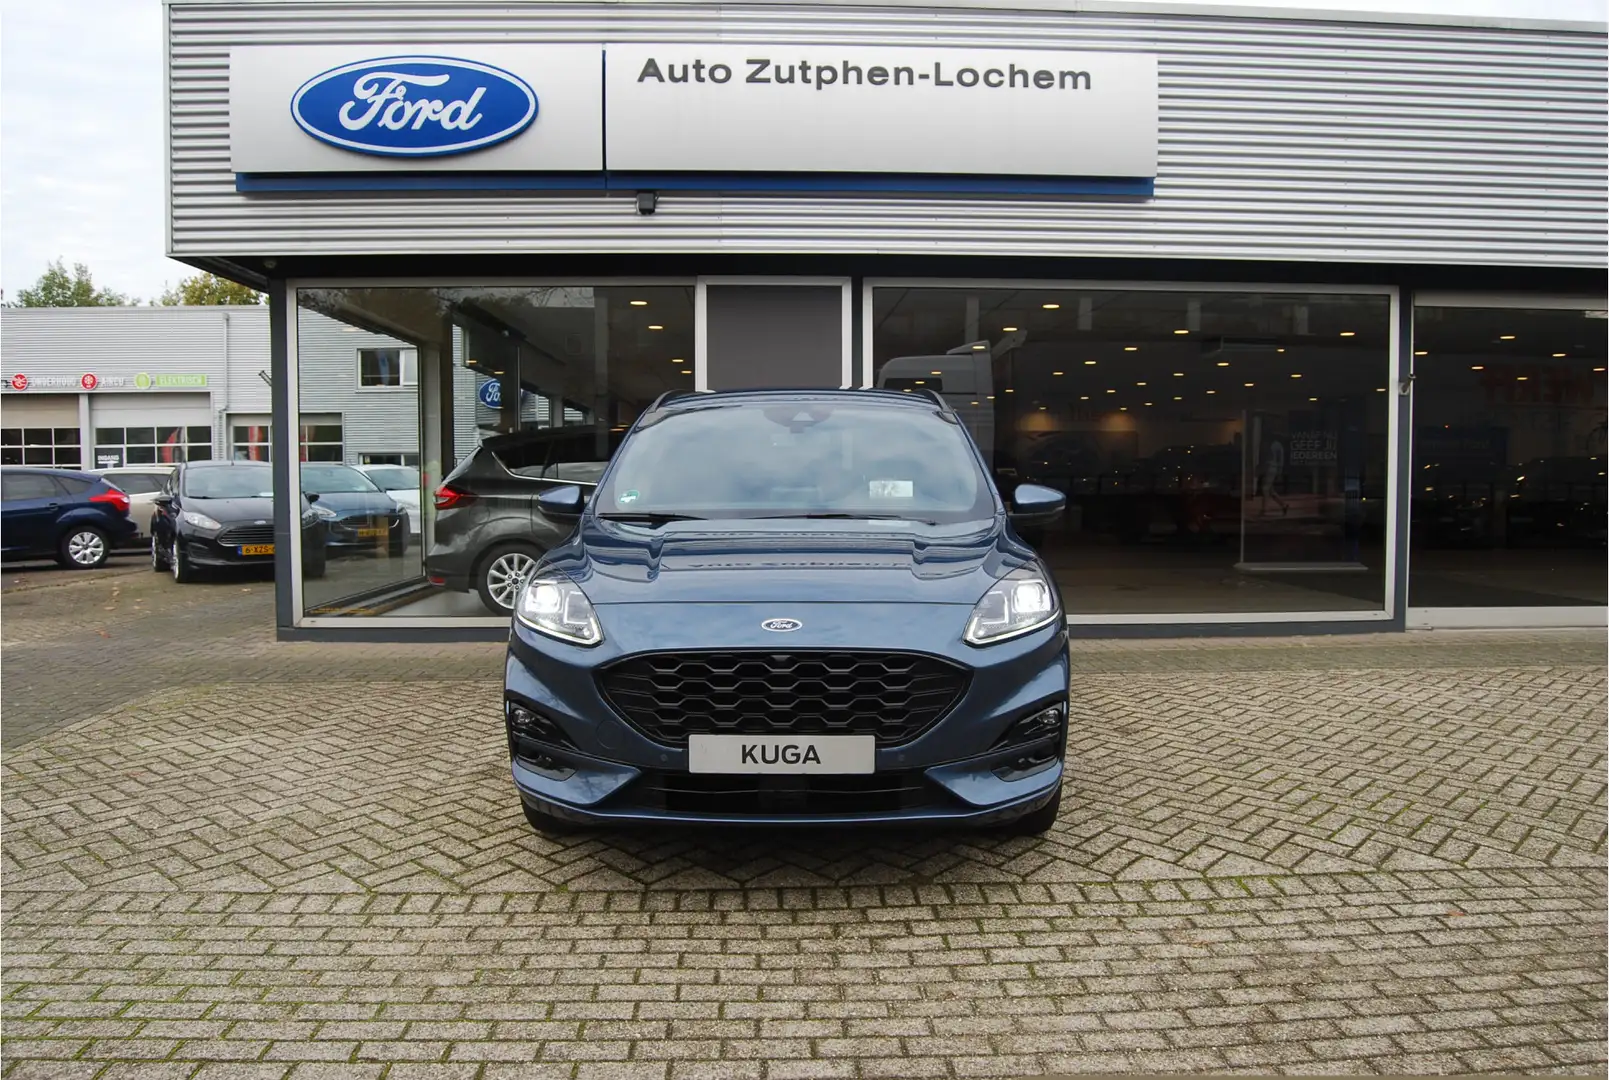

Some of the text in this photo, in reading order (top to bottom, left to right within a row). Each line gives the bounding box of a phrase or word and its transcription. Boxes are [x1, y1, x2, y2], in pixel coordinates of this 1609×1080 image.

[637, 57, 1091, 91] Auto Zutphen-Lochem
[338, 71, 487, 131] Ford
[159, 375, 203, 386] ELEKTRISCH
[1290, 440, 1321, 450] GEEF
[1291, 450, 1338, 460] IEDEREEN
[770, 621, 794, 629] Ford
[741, 744, 821, 764] KUGA
